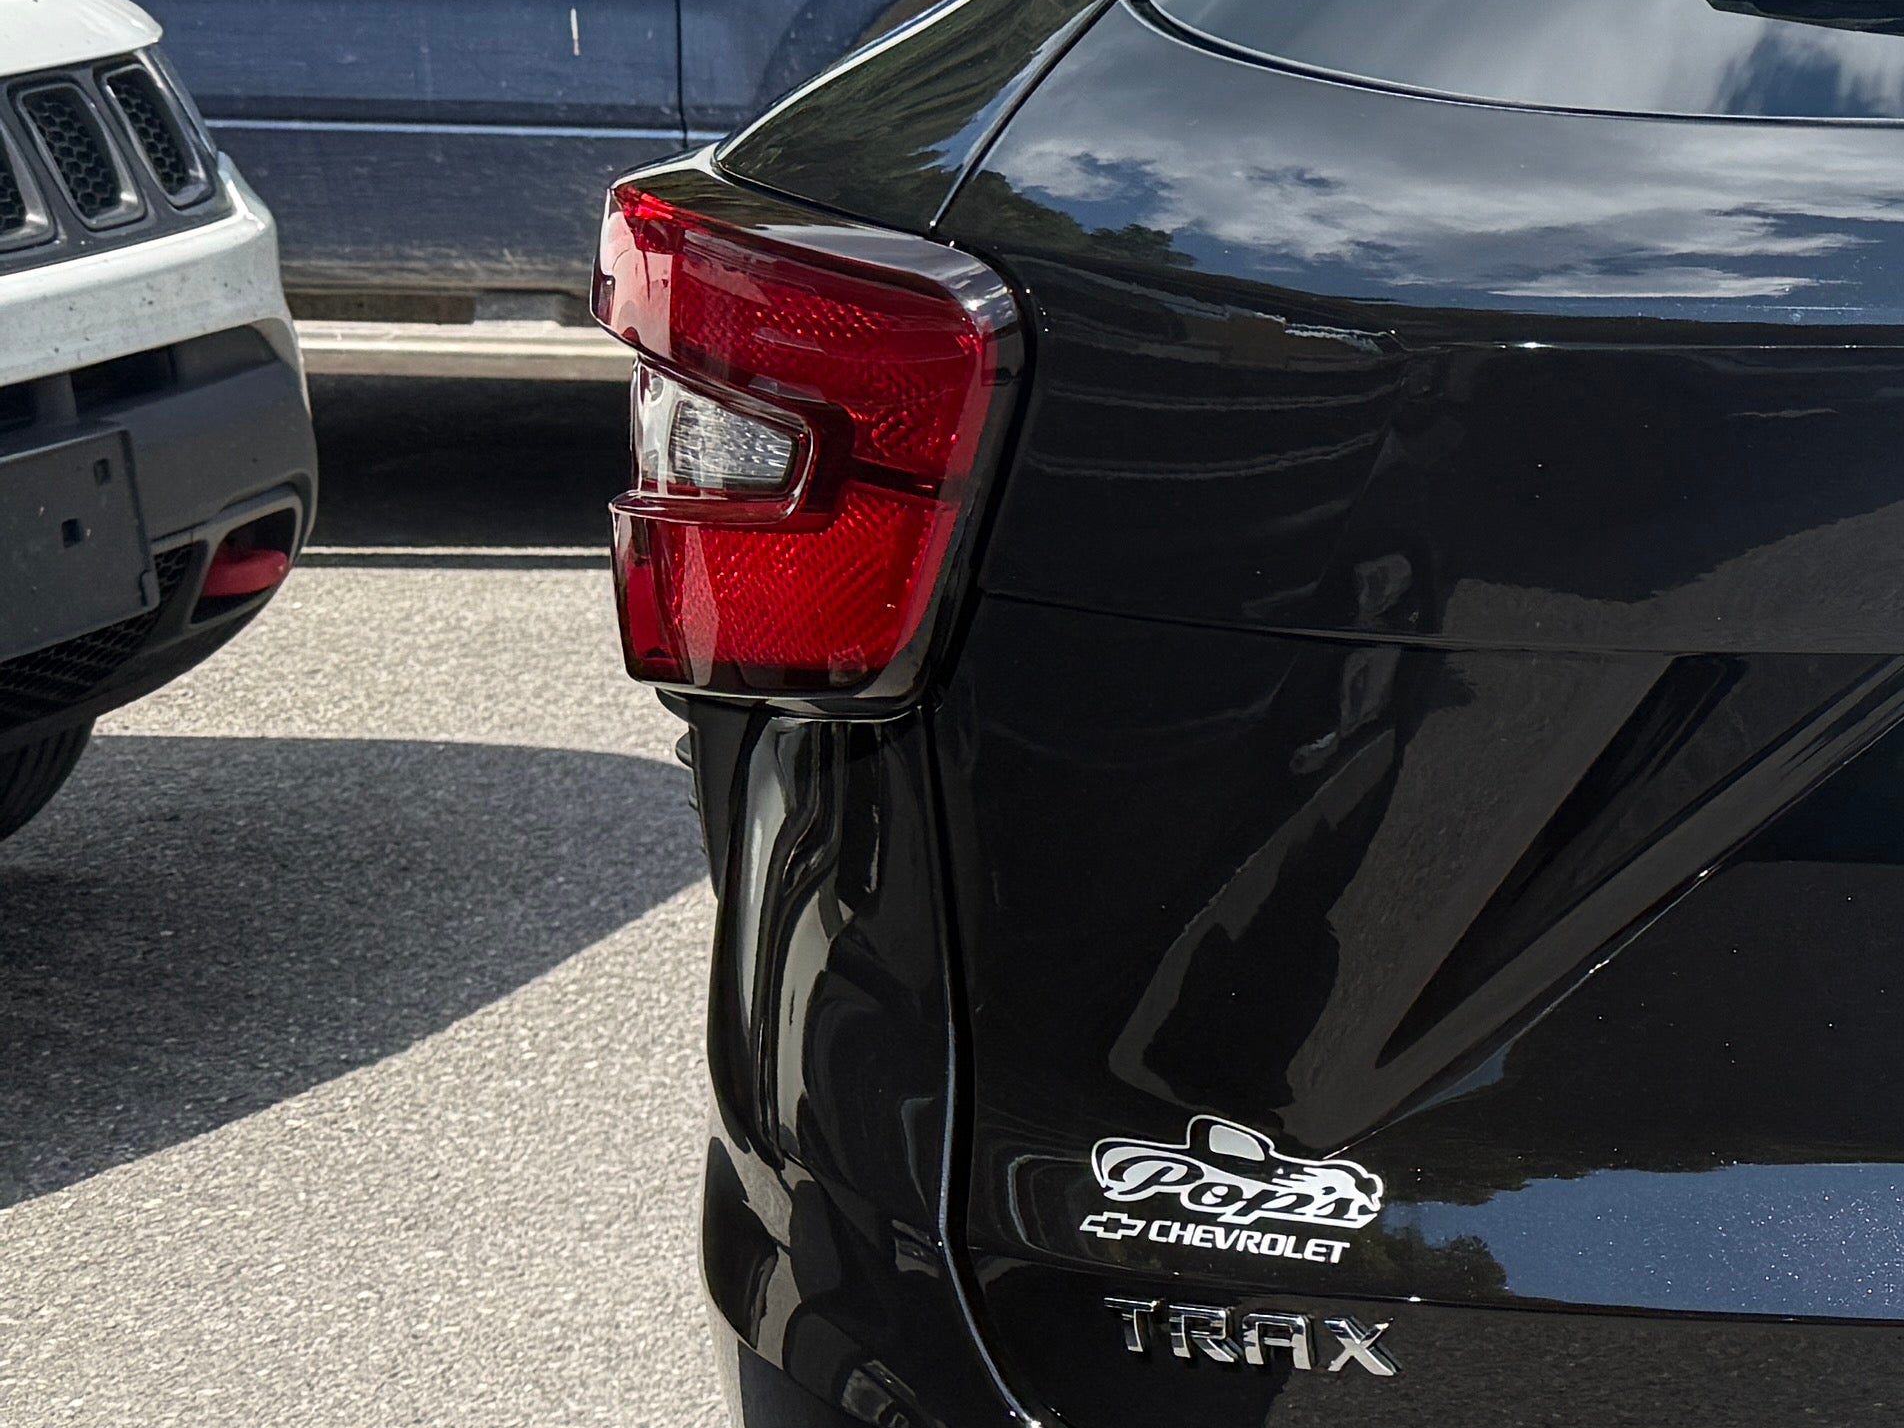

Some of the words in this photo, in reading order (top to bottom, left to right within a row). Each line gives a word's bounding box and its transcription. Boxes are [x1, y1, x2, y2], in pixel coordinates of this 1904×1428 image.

[1107, 1155, 1361, 1220] Pop's
[1148, 1220, 1351, 1264] CHEVROLET
[1104, 1297, 1401, 1376] TRAX
